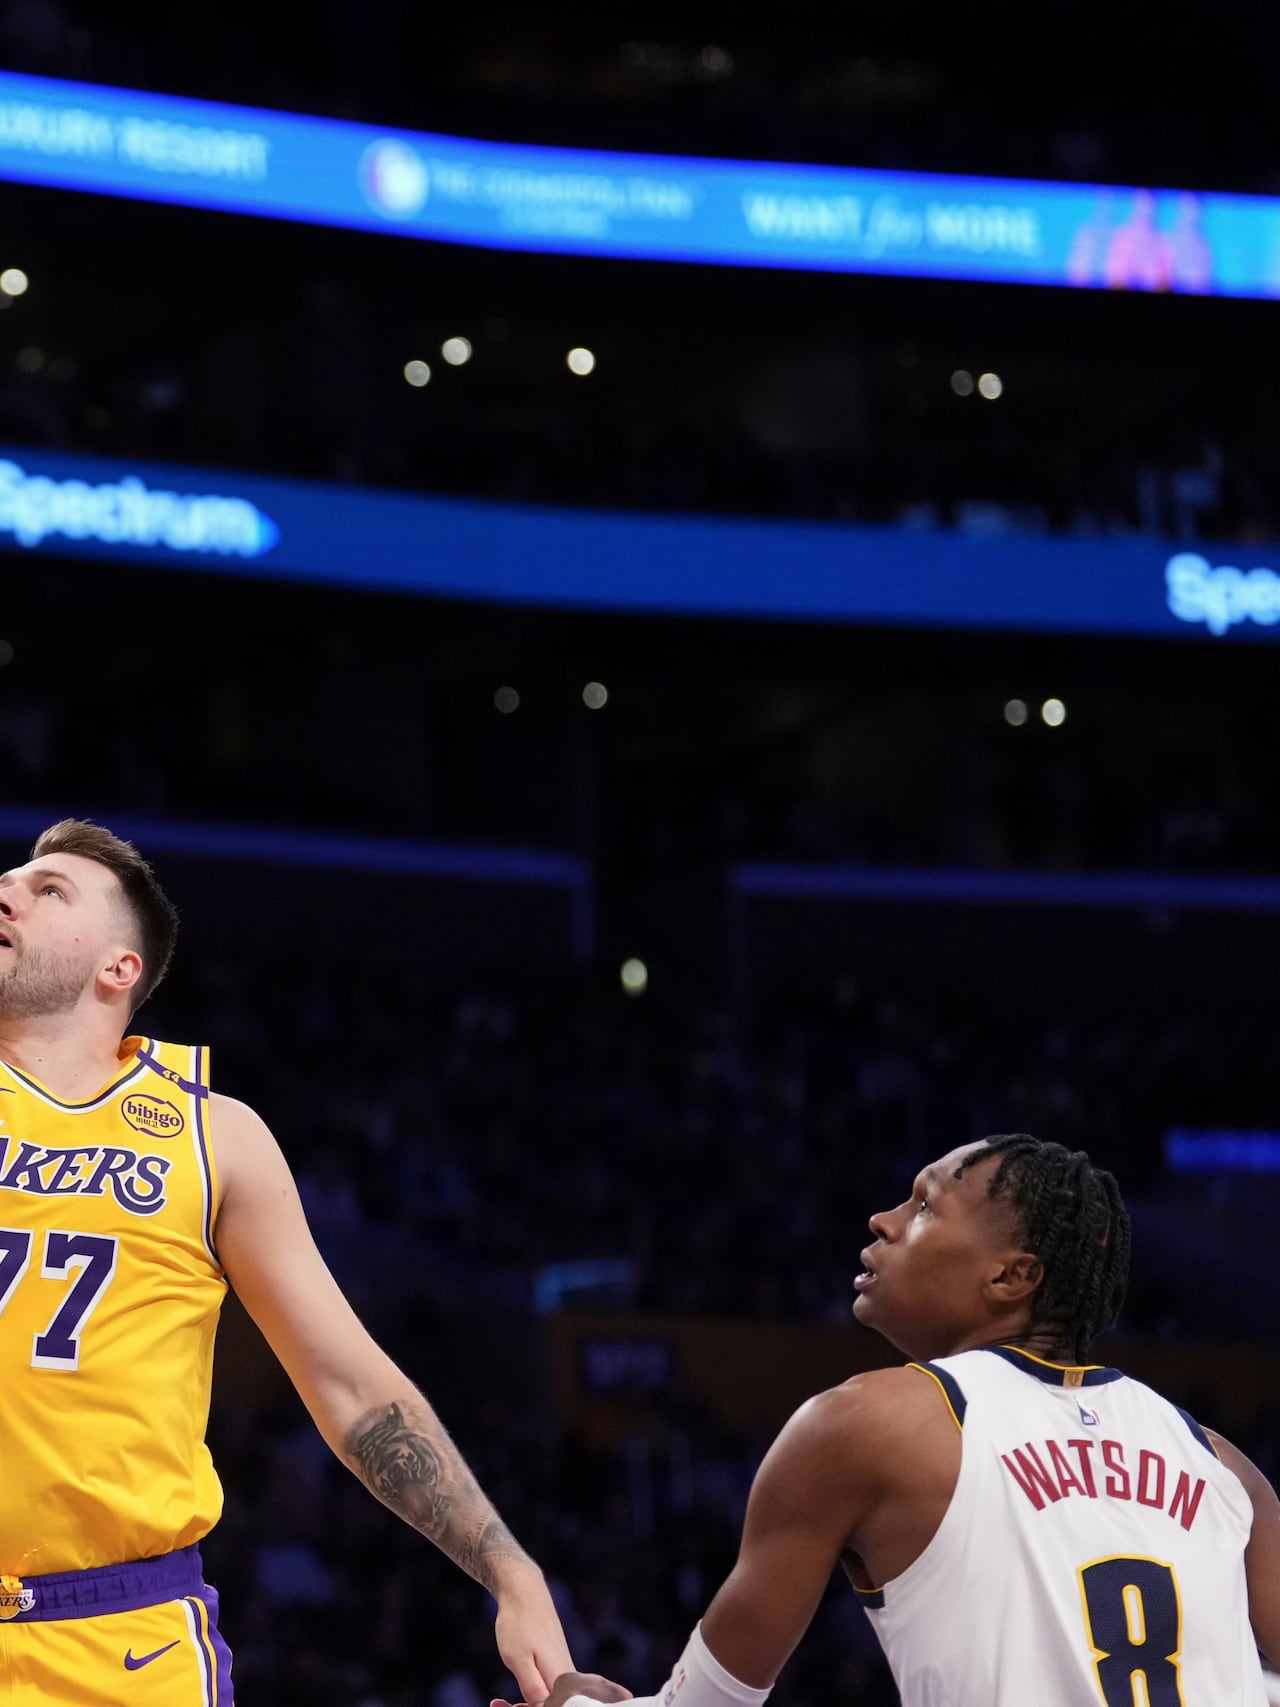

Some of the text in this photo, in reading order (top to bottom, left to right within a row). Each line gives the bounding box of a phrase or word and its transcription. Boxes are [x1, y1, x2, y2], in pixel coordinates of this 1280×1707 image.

[118, 116, 269, 184] RESORT
[742, 193, 861, 240] WANT
[925, 202, 1040, 257] MORE
[127, 1101, 181, 1128] bibigo
[1001, 1439, 1207, 1532] WATSON
[1076, 1553, 1184, 1707] 8
